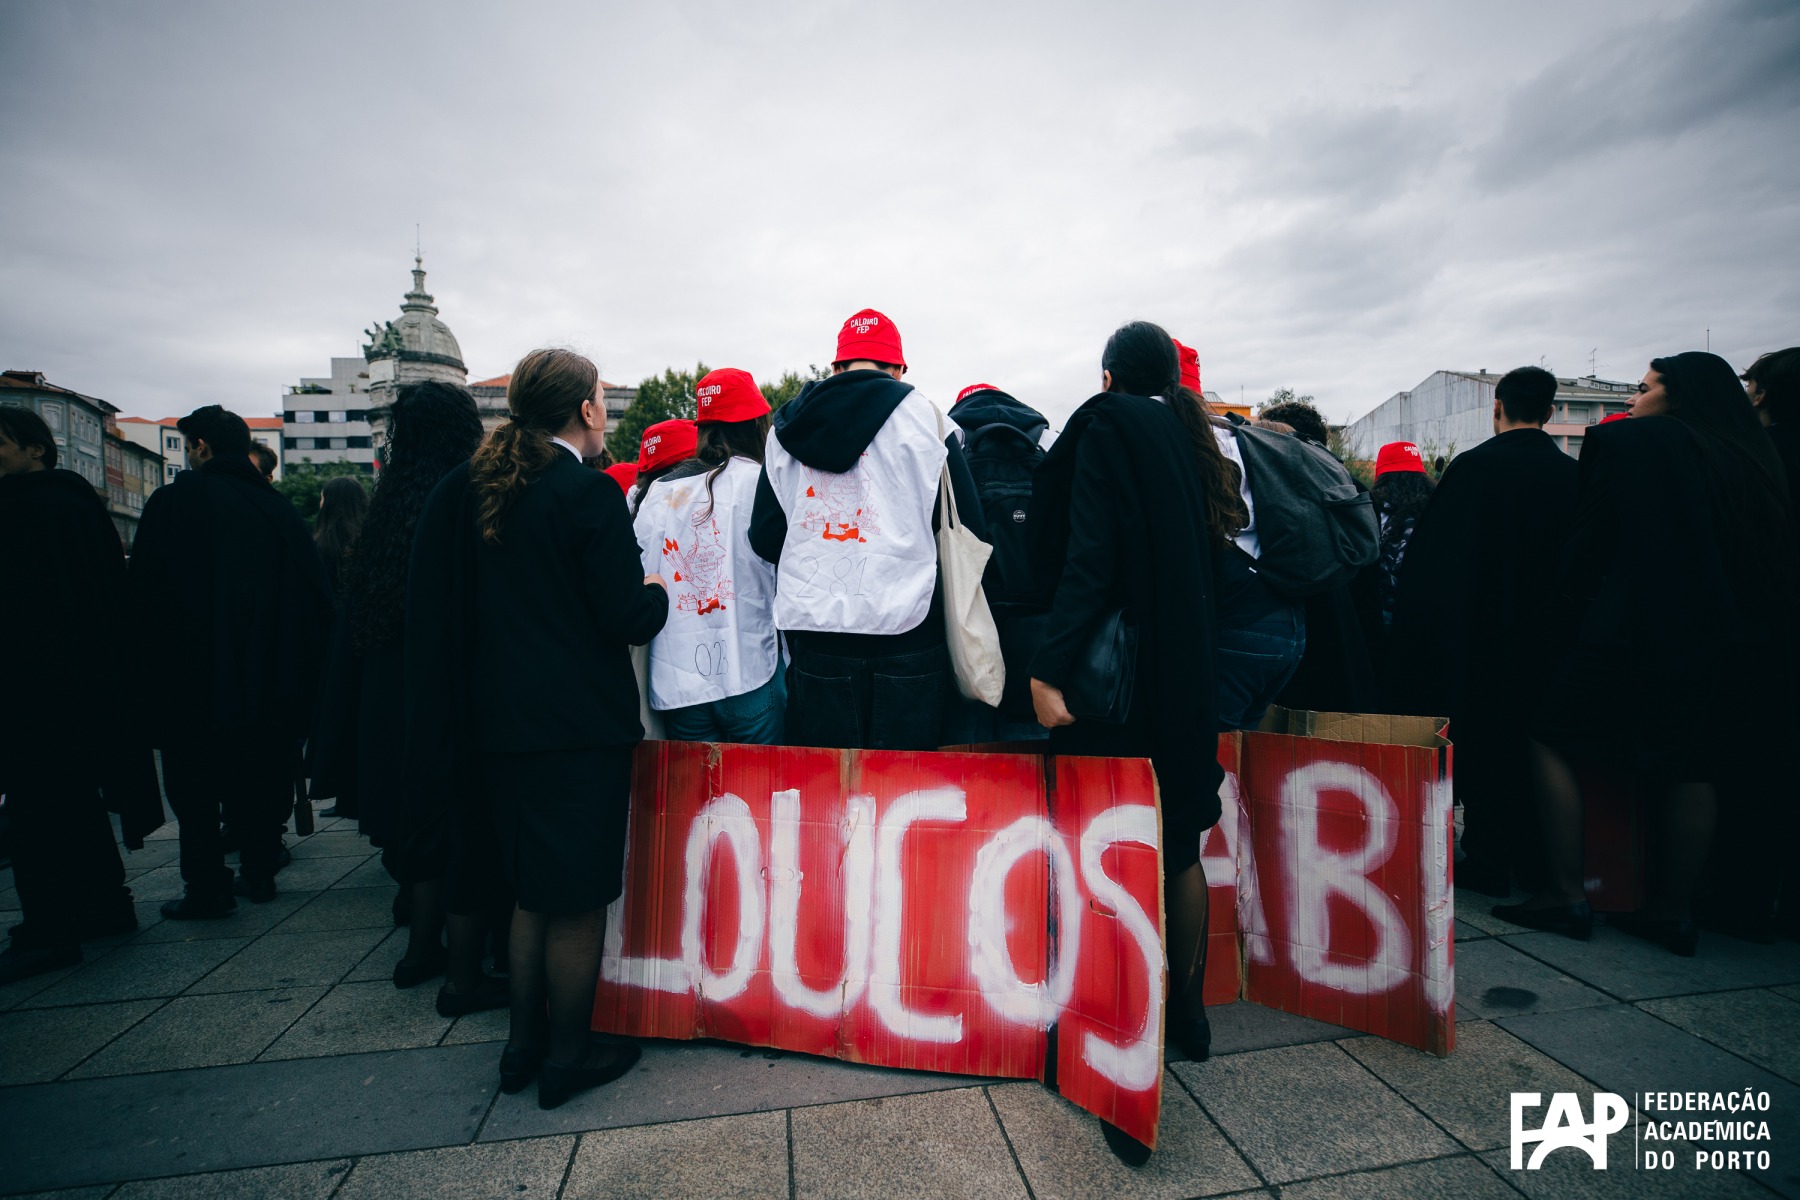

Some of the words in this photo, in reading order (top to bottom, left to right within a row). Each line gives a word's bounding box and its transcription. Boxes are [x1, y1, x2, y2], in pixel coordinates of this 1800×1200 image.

[856, 325, 870, 334] FEP
[701, 396, 712, 407] FEP
[796, 555, 868, 598] 281
[601, 787, 1161, 1092] LOUCOS
